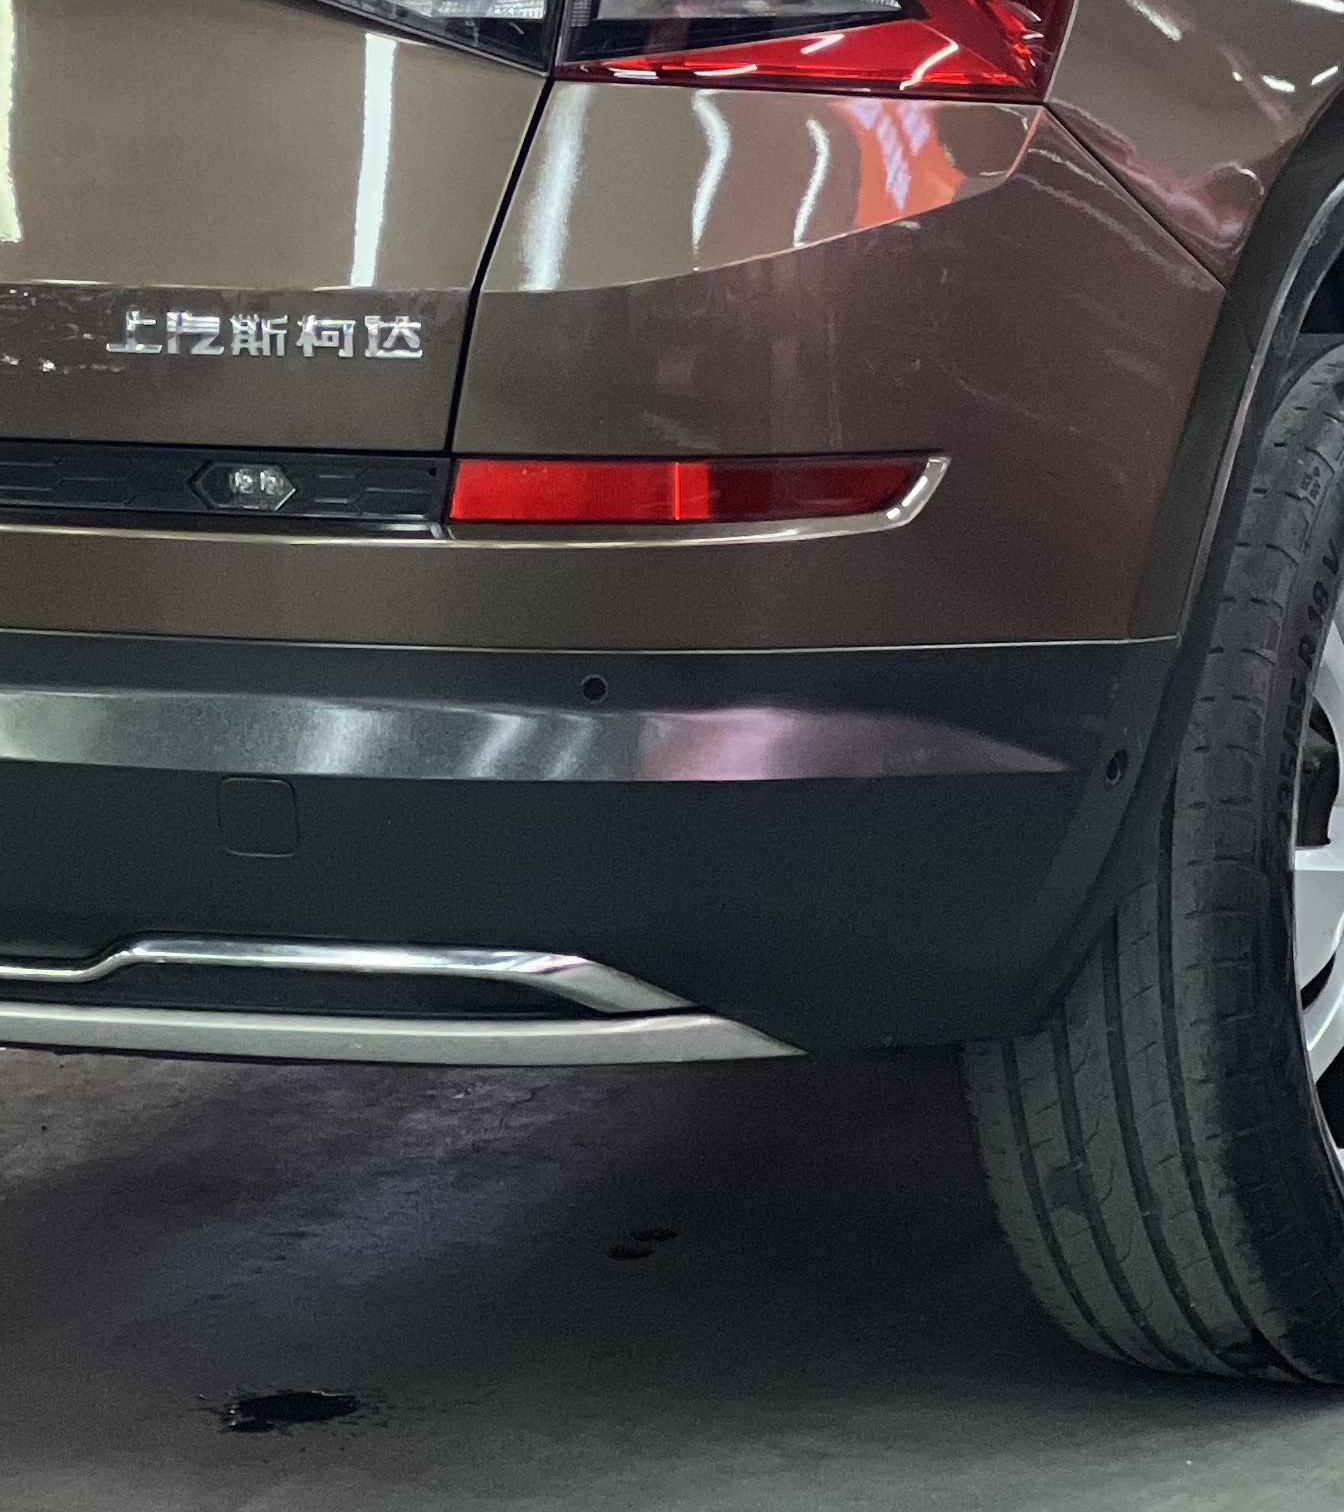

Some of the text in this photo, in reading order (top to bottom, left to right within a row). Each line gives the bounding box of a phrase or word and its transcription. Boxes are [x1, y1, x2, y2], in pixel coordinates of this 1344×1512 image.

[105, 309, 423, 359] 上汽斯柯达
